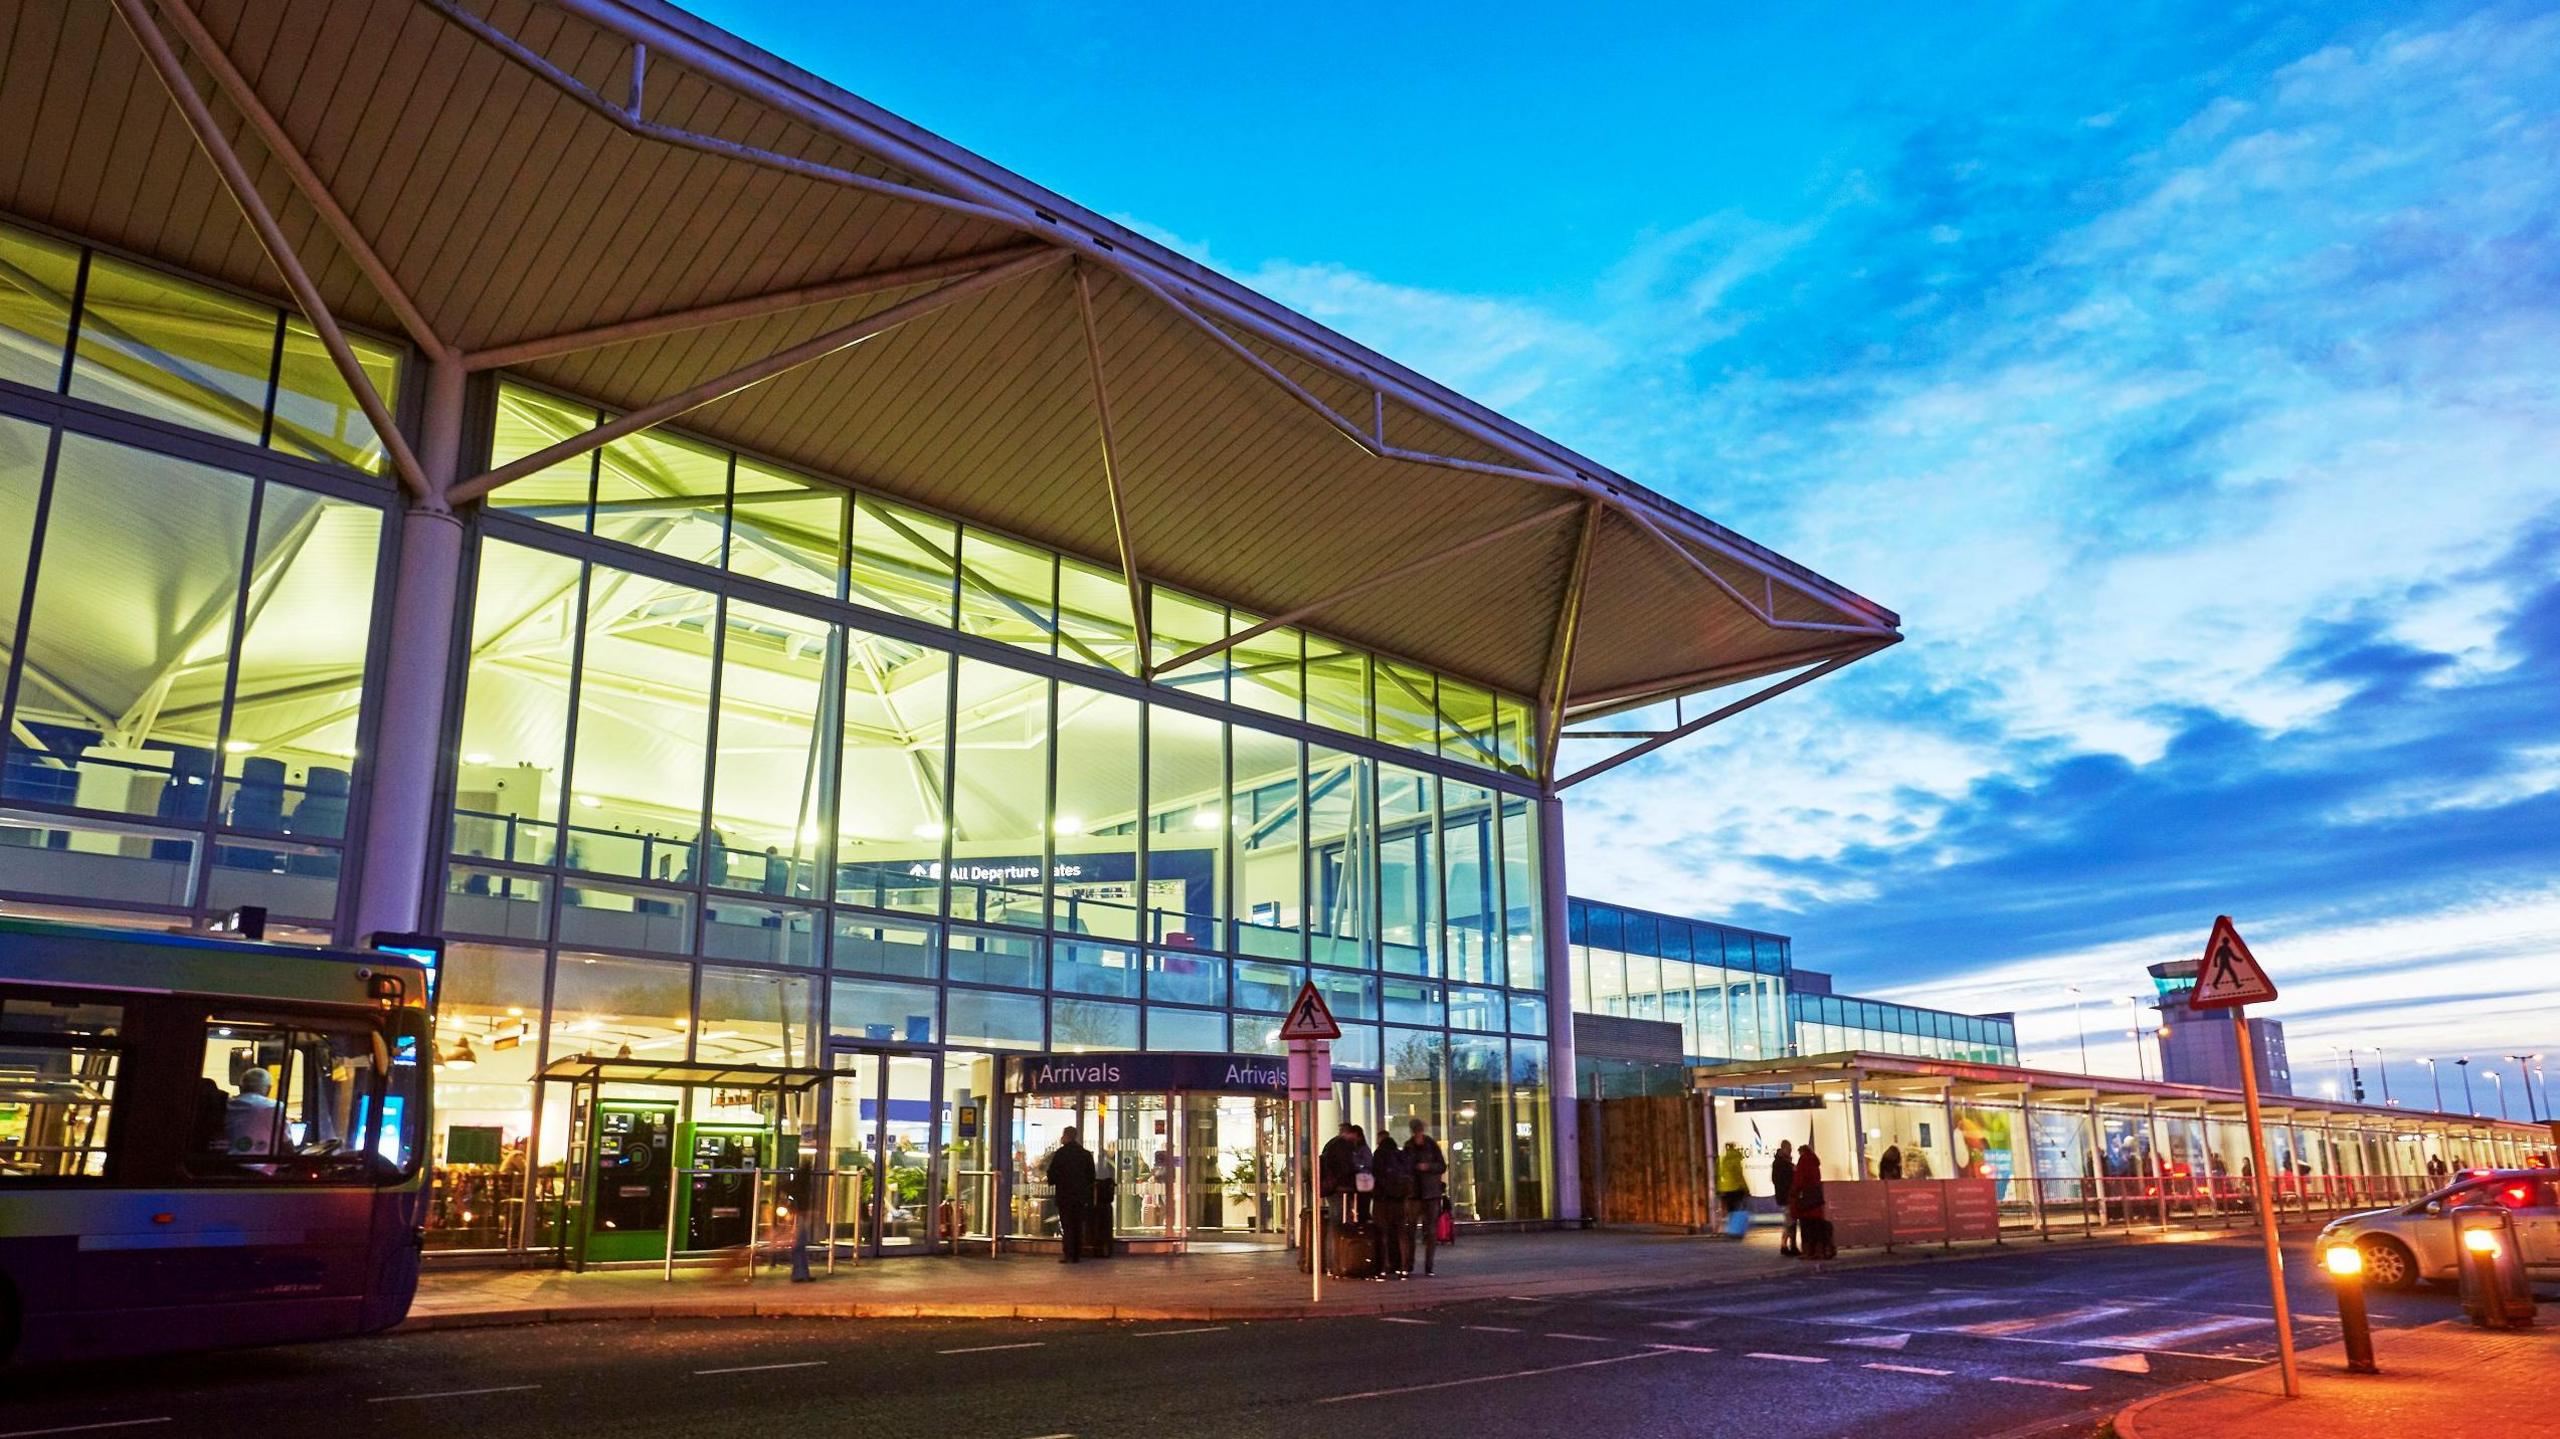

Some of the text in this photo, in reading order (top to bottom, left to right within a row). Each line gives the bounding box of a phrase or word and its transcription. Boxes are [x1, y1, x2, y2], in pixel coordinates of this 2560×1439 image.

[950, 864, 1082, 882] All Departure ates
[1039, 1062, 1120, 1083] Arrivals
[1224, 1063, 1288, 1086] Arrivals
